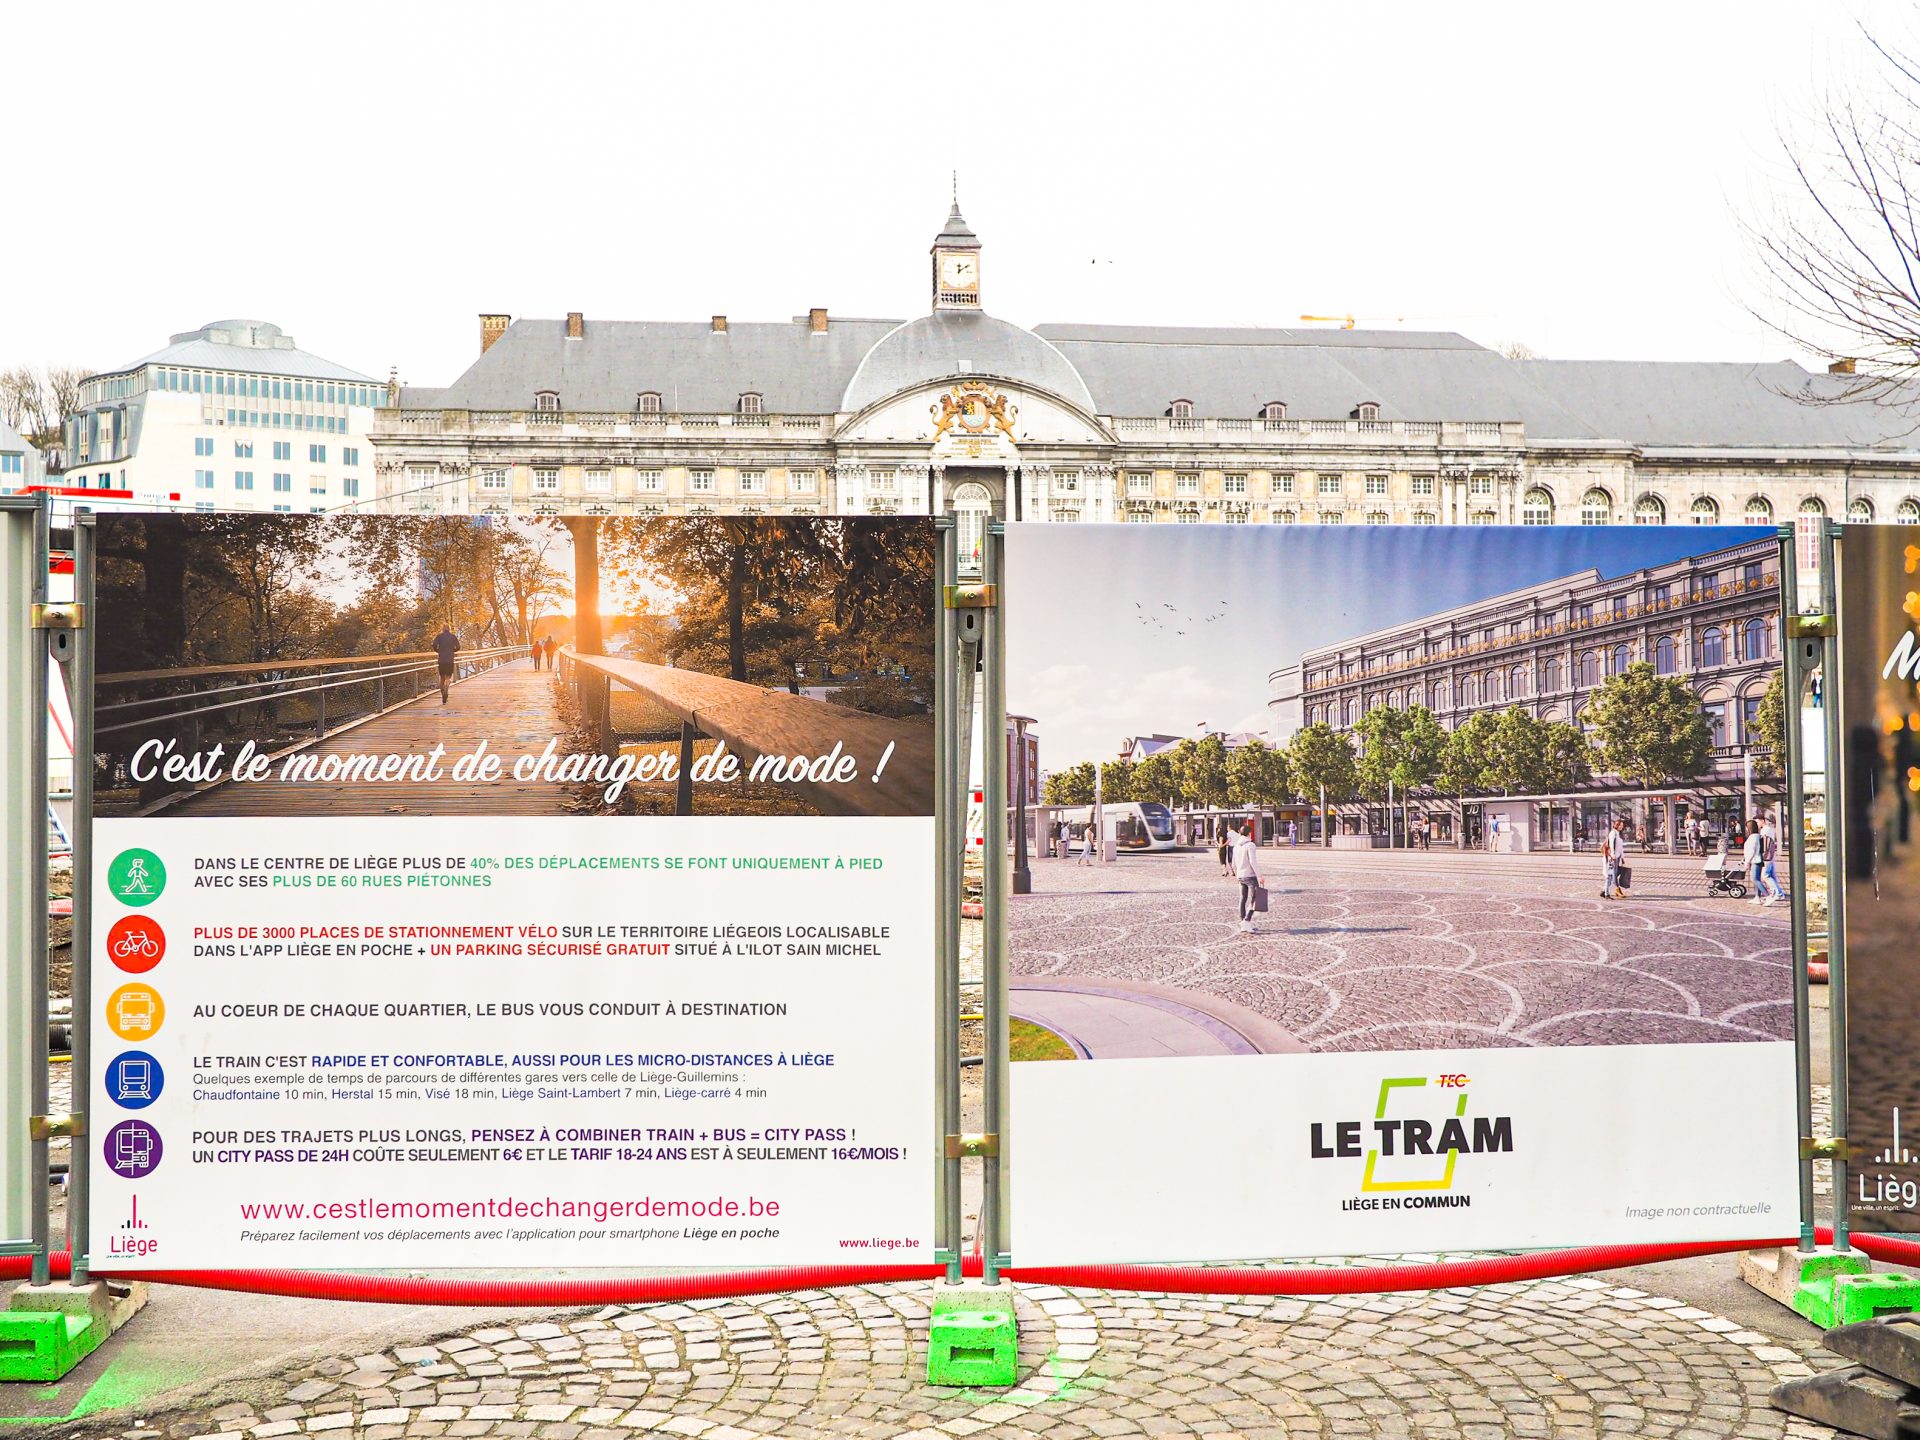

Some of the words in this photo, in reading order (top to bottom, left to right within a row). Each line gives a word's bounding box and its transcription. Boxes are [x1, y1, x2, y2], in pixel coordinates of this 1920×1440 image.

[130, 738, 224, 783] C'est
[231, 738, 273, 783] le
[281, 742, 446, 783] moment
[451, 739, 503, 783] de
[513, 737, 681, 804] changer
[690, 739, 741, 783] de
[748, 740, 858, 784] mode
[871, 740, 896, 784] !
[194, 857, 237, 870] DANS
[263, 857, 325, 870] CENTRE
[354, 854, 398, 870] LIÈGE
[402, 856, 442, 870] PLUS
[470, 857, 500, 870] 40%
[504, 856, 534, 869] DES
[539, 854, 660, 870] DÉPLACEMENTS
[664, 857, 684, 870] SE
[688, 857, 728, 870] FONT
[732, 857, 831, 870] UNIQUEMENT
[849, 857, 883, 870] PIED
[193, 875, 234, 888] AVEC
[238, 875, 269, 888] SES
[272, 875, 312, 888] PLUS
[340, 875, 358, 888] 60
[362, 874, 403, 887] RUES
[407, 872, 492, 887] PIÉTONNES
[193, 926, 234, 940] PLUS
[262, 926, 296, 939] 3000
[299, 926, 360, 940] PLACES
[388, 925, 515, 939] STATIONNEMENT
[517, 923, 558, 940] VÉLO
[561, 925, 593, 938] SUR
[619, 925, 709, 938] TERRITOIRE
[712, 923, 782, 940] LIÉGEOIS
[786, 925, 891, 939] LOCALISABLE
[193, 944, 236, 957] DANS
[240, 944, 283, 957] L'APP
[287, 941, 332, 957] LIÈGE
[336, 944, 356, 956] EN
[360, 943, 414, 957] POCHE
[430, 943, 452, 956] UN
[455, 943, 523, 956] PARKING
[527, 940, 603, 956] SÉCURISÉ
[606, 943, 671, 956] GRATUIT
[674, 940, 718, 956] SITUÉ
[736, 943, 783, 956] L'ILOT
[786, 943, 821, 956] SAIN
[825, 943, 882, 956] MICHEL
[192, 1004, 216, 1018] AU
[220, 1004, 279, 1018] COEUR
[309, 1003, 380, 1018] CHAQUE
[383, 1003, 471, 1019] QUARTIER,
[501, 1002, 535, 1016] BUS
[538, 1002, 584, 1017] VOUS
[588, 1002, 661, 1016] CONDUIT
[681, 1002, 787, 1016] DESTINATION
[193, 1056, 213, 1069] LE
[215, 1055, 261, 1069] TRAIN
[264, 1055, 308, 1068] C'EST
[311, 1055, 367, 1068] RAPIDE
[370, 1055, 390, 1068] ET
[393, 1054, 508, 1069] CONFORTABLE,
[511, 1054, 556, 1067] AUSSI
[559, 1054, 602, 1067] POUR
[605, 1054, 634, 1067] LES
[637, 1053, 774, 1067] MICRO-DISTANCES
[791, 1051, 835, 1067] LIÈGE
[192, 1073, 251, 1087] Quelques
[254, 1072, 305, 1087] exemple
[308, 1072, 324, 1084] de
[326, 1073, 364, 1086] temps
[366, 1072, 382, 1084] de
[385, 1074, 438, 1086] parcours
[440, 1072, 456, 1084] de
[459, 1071, 522, 1083] différentes
[524, 1073, 559, 1086] gares
[561, 1073, 588, 1083] vers
[590, 1071, 618, 1083] celle
[621, 1071, 637, 1083] de
[640, 1070, 739, 1085] Liège-Guillemins
[1439, 1073, 1467, 1088] TEC
[192, 1088, 281, 1101] Chaudfontaine
[284, 1088, 299, 1100] 10
[302, 1088, 328, 1101] min,
[331, 1088, 374, 1100] Herstal
[377, 1088, 393, 1100] 15
[395, 1088, 421, 1100] min,
[424, 1087, 451, 1100] Visé
[455, 1088, 469, 1099] 18
[472, 1087, 498, 1101] min,
[501, 1087, 534, 1102] Liège
[537, 1087, 621, 1099] Saint-Lambert
[635, 1087, 661, 1100] min,
[664, 1087, 731, 1101] Liège-carré
[745, 1087, 767, 1098] min
[192, 1130, 238, 1145] POUR
[243, 1130, 276, 1144] DES
[280, 1129, 354, 1144] TRAJETS
[358, 1129, 401, 1145] PLUS
[405, 1129, 466, 1145] LONGS,
[471, 1128, 535, 1143] PENSEZ
[555, 1128, 642, 1142] COMBINER
[645, 1128, 695, 1142] TRAIN
[713, 1128, 747, 1145] BUS
[764, 1128, 801, 1142] CITY
[804, 1128, 847, 1142] PASS
[1311, 1121, 1362, 1159] LE
[1373, 1116, 1514, 1157] TRAM
[192, 1150, 214, 1164] UN
[217, 1149, 252, 1164] CITY
[254, 1149, 295, 1163] PASS
[297, 1149, 319, 1163] DE
[321, 1148, 350, 1163] 24H
[352, 1145, 405, 1162] COÛTE
[408, 1147, 501, 1162] SEULEMENT
[502, 1147, 523, 1161] 6€
[526, 1148, 546, 1161] ET
[548, 1147, 568, 1161] LE
[570, 1147, 613, 1161] TARIF
[616, 1147, 653, 1161] 18-24
[655, 1147, 688, 1161] ANS
[690, 1147, 720, 1161] EST
[736, 1147, 829, 1161] SEULEMENT
[831, 1147, 900, 1161] 16€/MOIS
[1859, 1173, 1920, 1209] Lièg
[240, 1195, 780, 1223] www.cestlemomentdechangerdemode.be
[1342, 1196, 1380, 1211] LIÈGE
[1382, 1198, 1401, 1210] EN
[1403, 1195, 1471, 1209] COMMUN
[1625, 1205, 1664, 1220] Image
[1667, 1206, 1690, 1217] non
[1693, 1202, 1772, 1216] contractuelle
[240, 1230, 296, 1244] Préparez
[298, 1229, 360, 1241] facilement
[363, 1231, 385, 1241] vos
[387, 1228, 471, 1243] déplacements
[473, 1230, 503, 1240] avec
[506, 1227, 576, 1242] l'application
[578, 1230, 607, 1242] pour
[609, 1227, 680, 1241] smartphone
[683, 1227, 718, 1242] Liège
[721, 1229, 737, 1239] en
[739, 1227, 780, 1241] poche
[839, 1237, 920, 1251] www.liege.be
[111, 1235, 158, 1256] Liège
